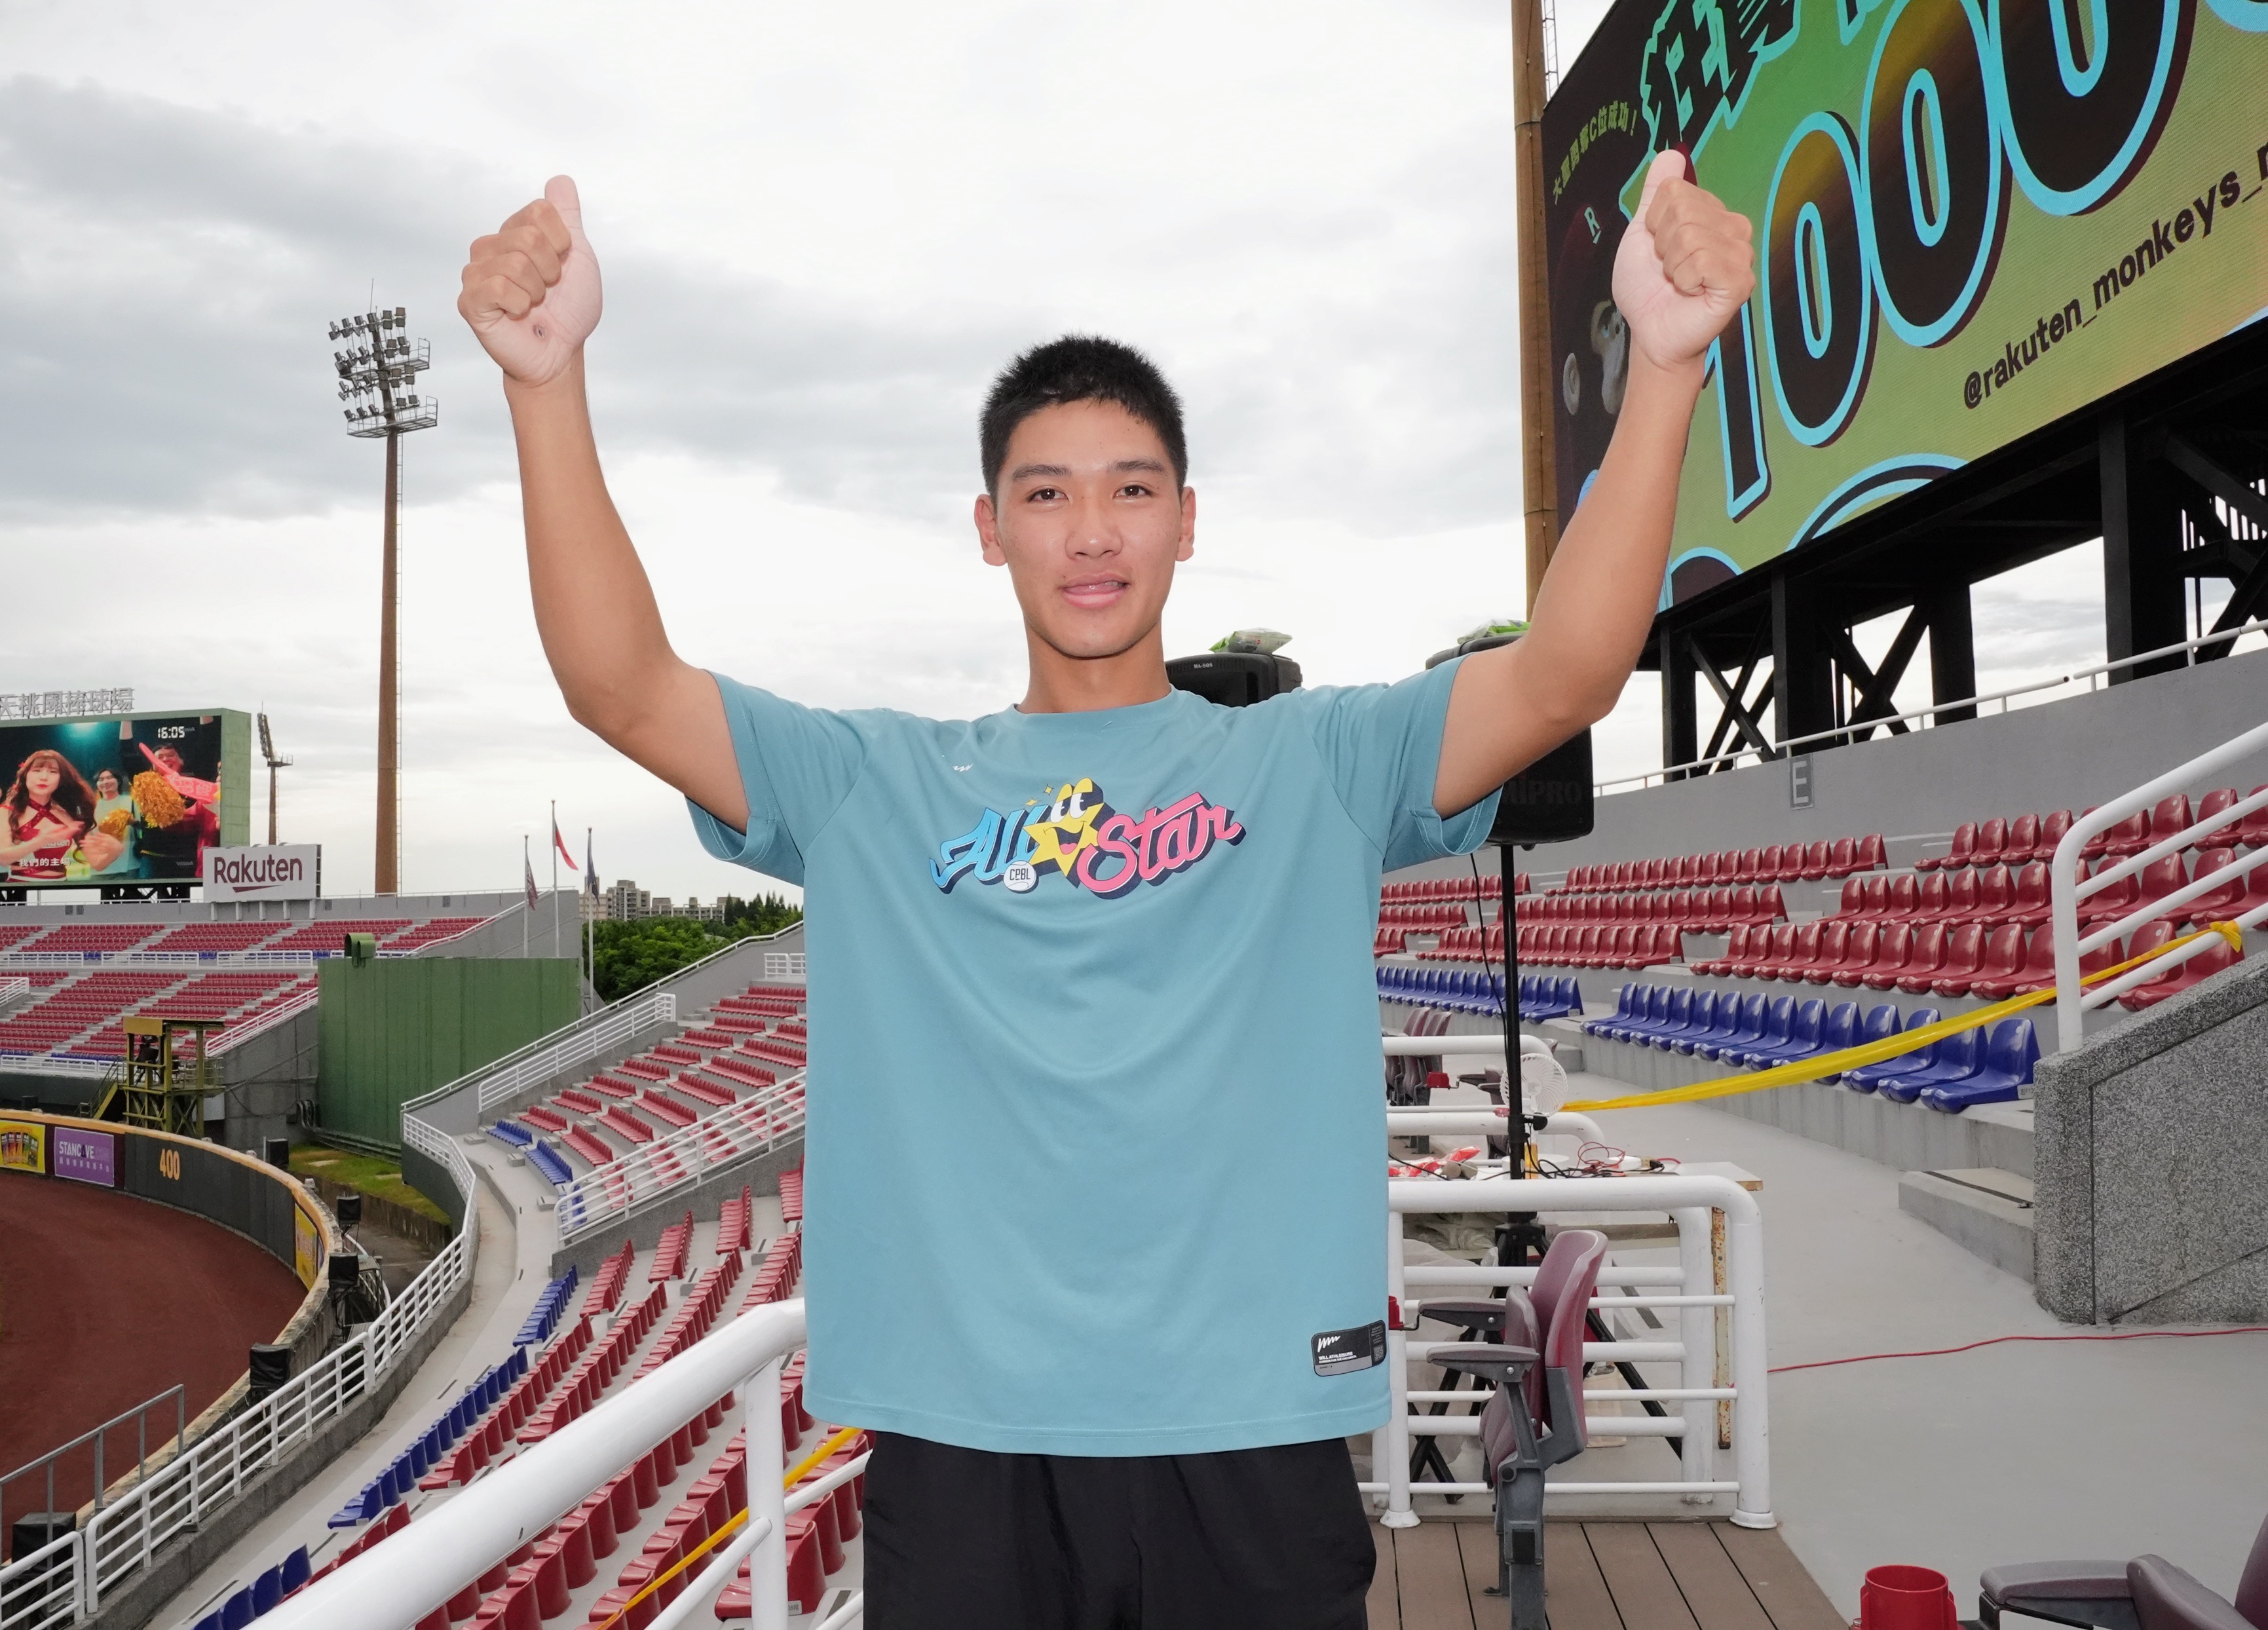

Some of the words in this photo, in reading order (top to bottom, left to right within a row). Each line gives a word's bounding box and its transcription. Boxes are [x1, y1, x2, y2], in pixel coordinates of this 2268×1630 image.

[157, 726, 185, 738] 16:05
[1792, 761, 1808, 805] E
[1076, 791, 1246, 900] Star
[214, 854, 303, 884] Rakuten
[1010, 868, 1030, 881] CPBL
[59, 1141, 95, 1159] STANCAVE
[159, 1148, 180, 1181] 400
